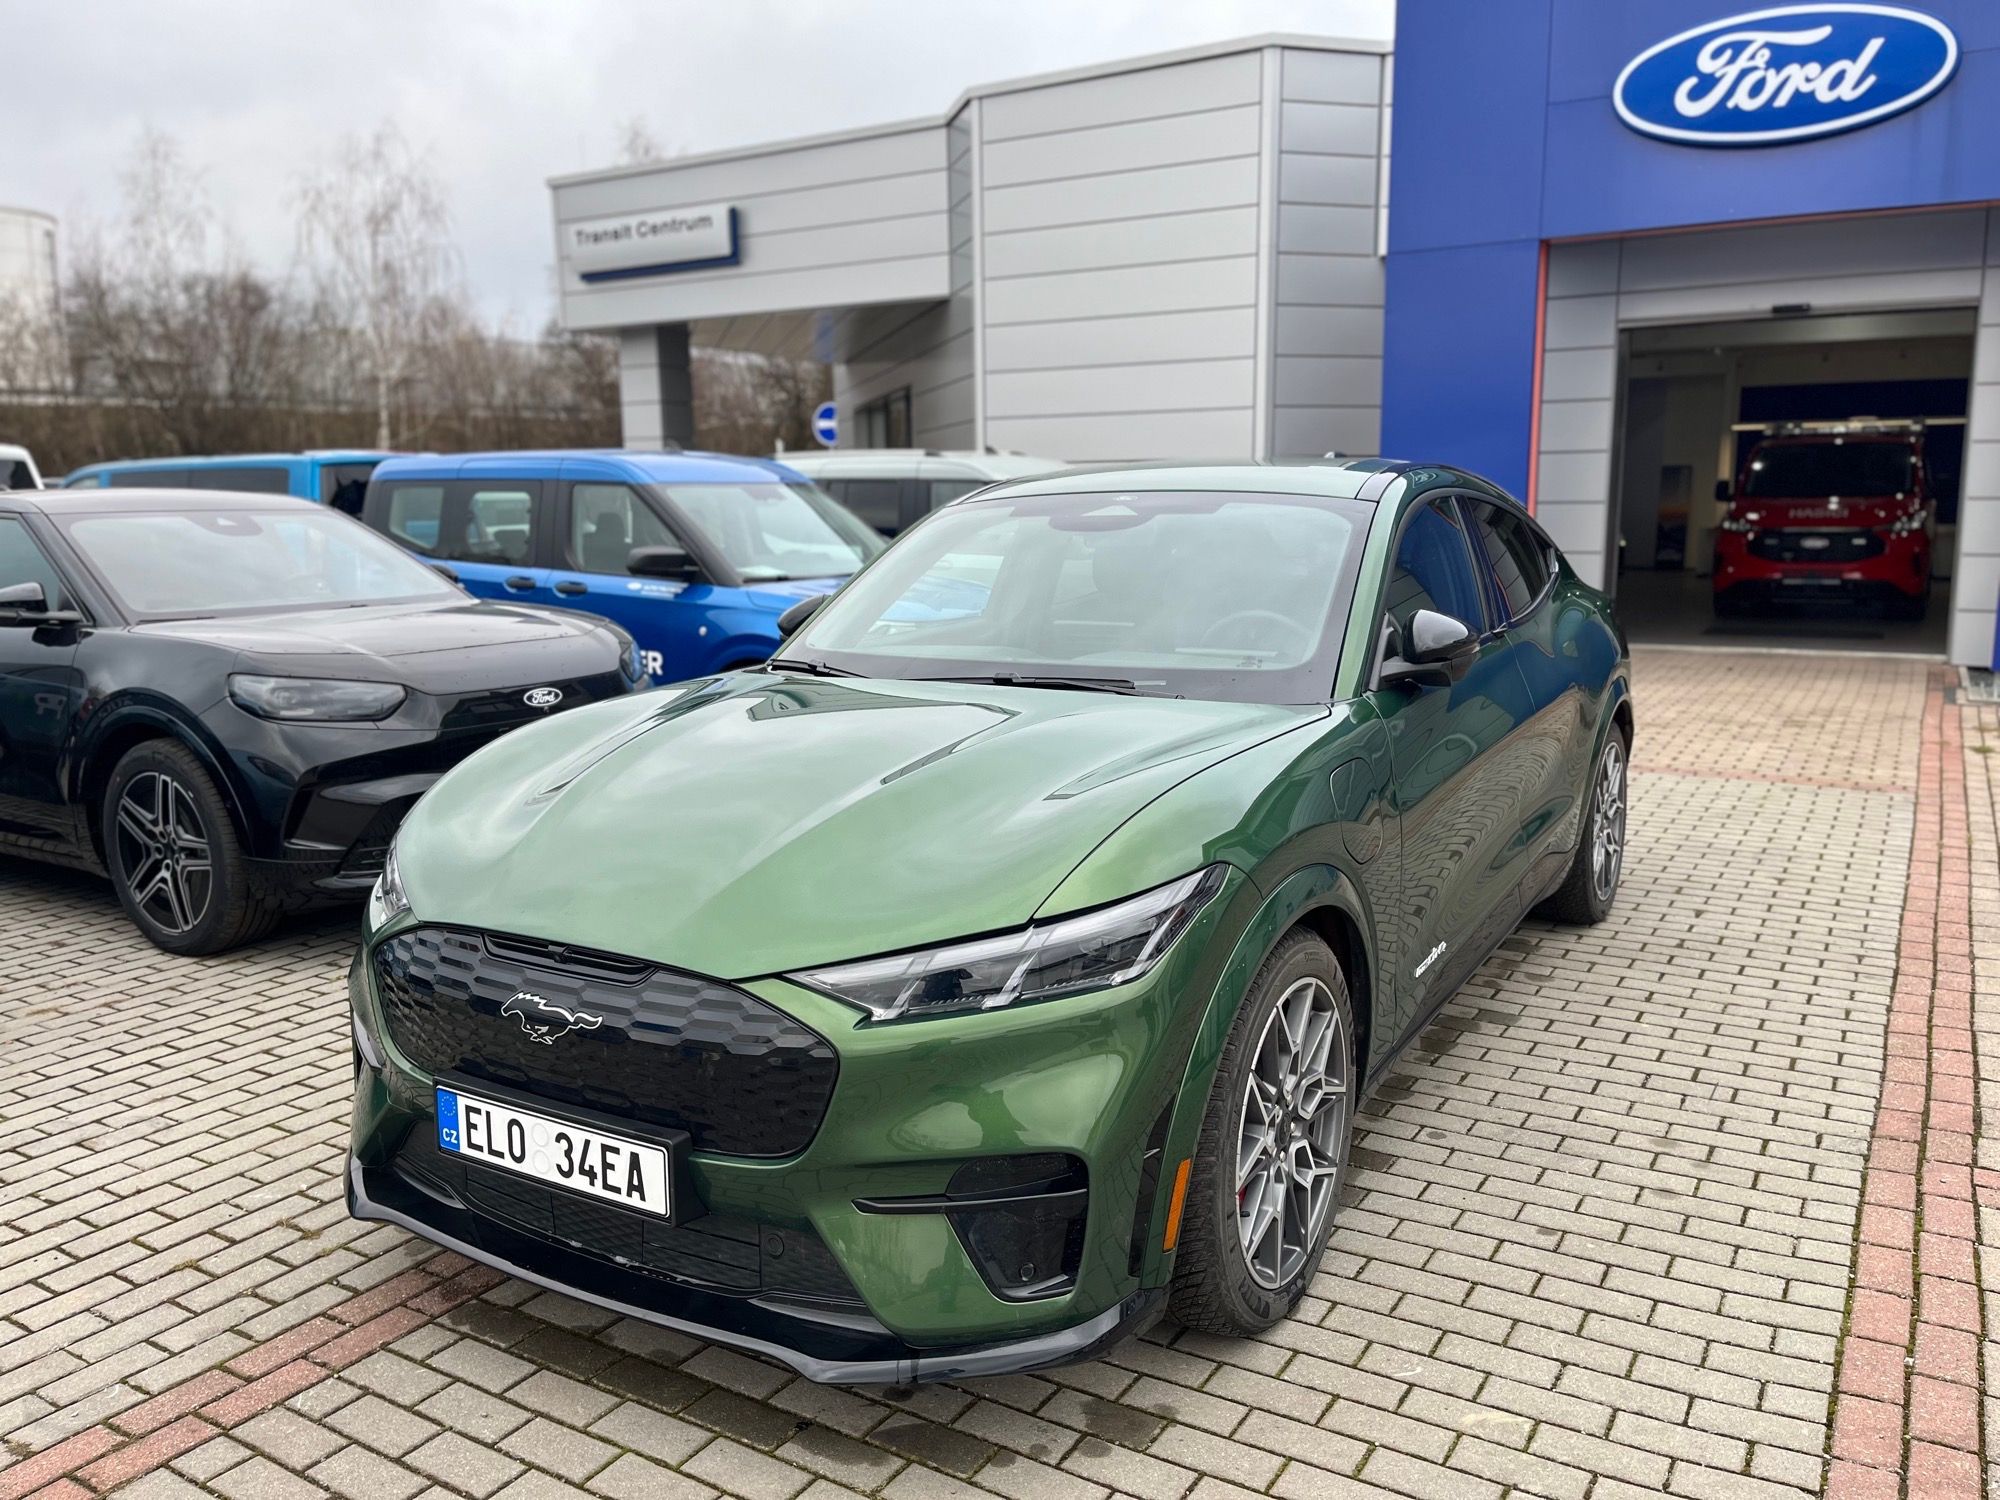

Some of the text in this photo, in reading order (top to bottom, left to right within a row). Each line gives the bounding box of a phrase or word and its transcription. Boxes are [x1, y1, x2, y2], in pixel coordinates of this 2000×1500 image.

[1674, 25, 1885, 118] Ford
[575, 215, 712, 245] Transit Centrum
[532, 690, 556, 704] Ford
[442, 1127, 458, 1144] CZ
[554, 1131, 647, 1203] 34EA
